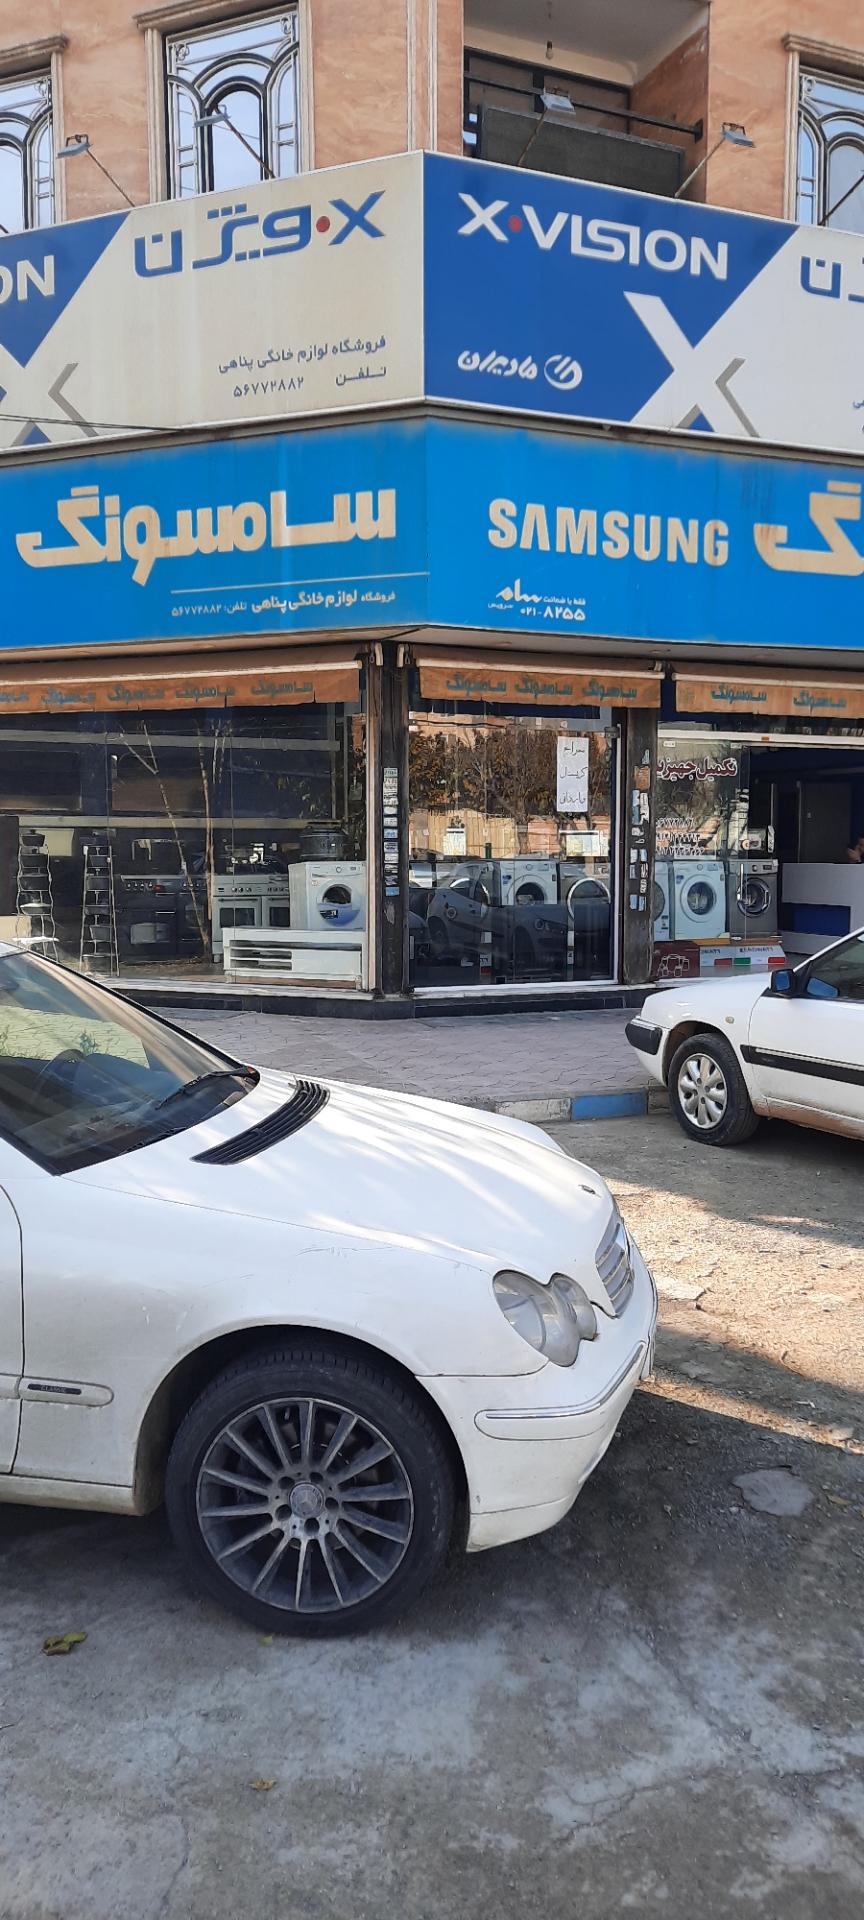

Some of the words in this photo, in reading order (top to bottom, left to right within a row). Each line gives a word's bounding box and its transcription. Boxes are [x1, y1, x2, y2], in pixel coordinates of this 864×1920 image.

[297, 343, 328, 363] لوازم
[332, 335, 386, 354] فروشگاه
[218, 355, 253, 374] پناهی
[257, 348, 294, 369] خانگی
[457, 350, 538, 380] مادیران
[233, 376, 304, 397] ۵۶۷۷۲۸۸۲
[335, 366, 387, 387] تلفن
[15, 485, 396, 587] سامسونگ
[488, 498, 729, 567] SAMSUNG
[251, 595, 287, 614] پناهی
[288, 591, 325, 611] خانگی
[324, 589, 357, 608] لوازم
[361, 591, 396, 604] فروشگاه
[696, 756, 737, 781] تکمیل
